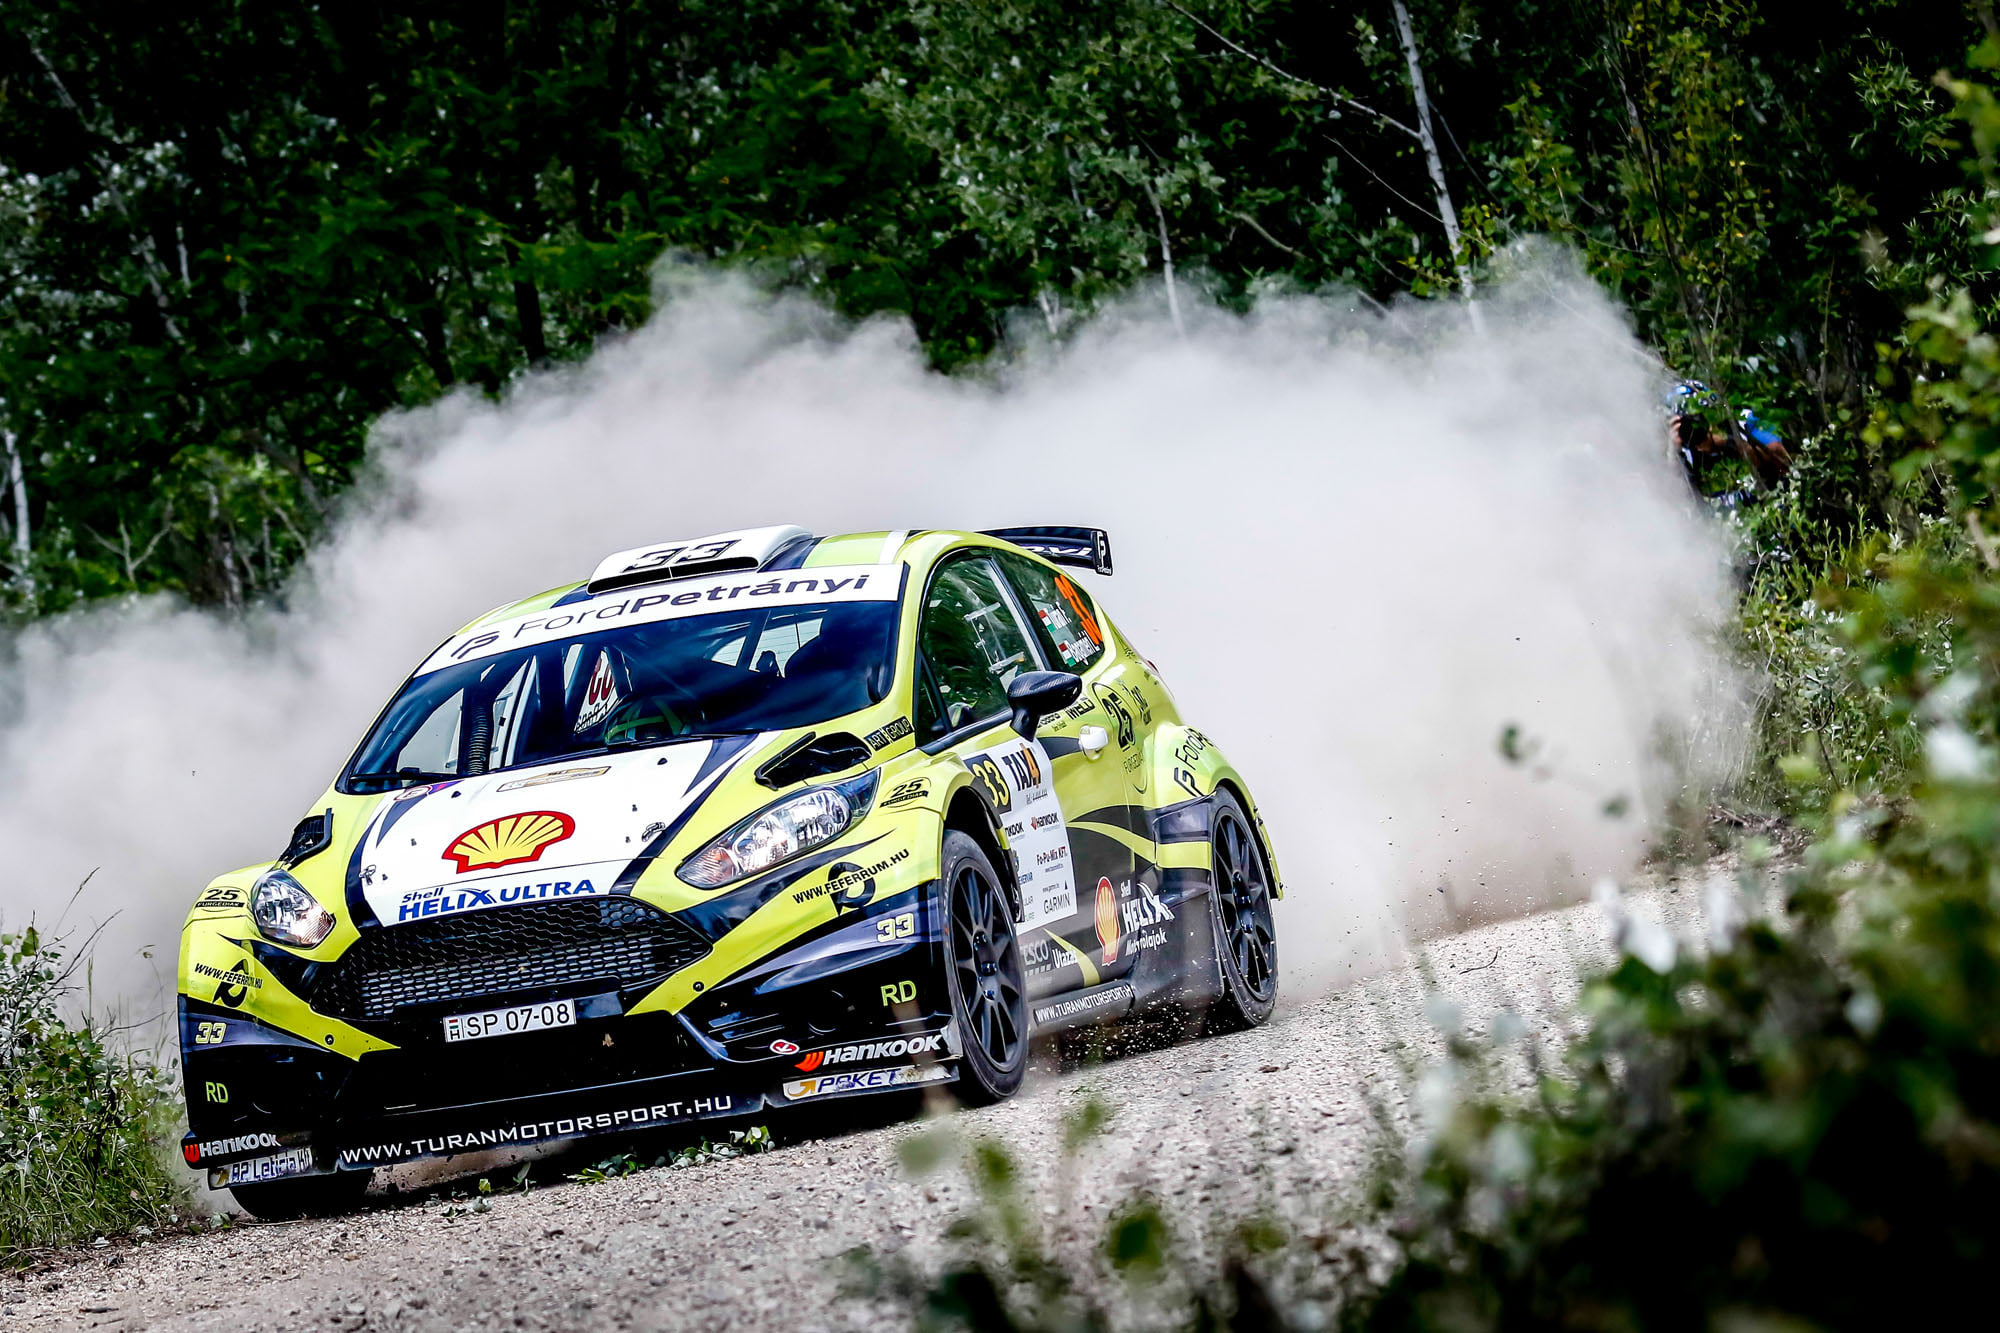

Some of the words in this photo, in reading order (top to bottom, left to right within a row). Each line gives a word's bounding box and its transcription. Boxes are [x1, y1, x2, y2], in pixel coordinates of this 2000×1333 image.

[620, 540, 741, 573] 33
[514, 575, 870, 638] FordPetrányi
[1054, 573, 1104, 645] 33
[868, 732, 887, 749] ART
[886, 718, 910, 739] GROUP
[890, 778, 925, 798] 25
[972, 760, 1009, 808] 33
[792, 849, 910, 904] WWW.FEFERRUM.HU
[1121, 880, 1131, 897] Shell
[205, 889, 240, 901] 25
[399, 888, 497, 921] HELIX
[500, 880, 595, 902] ULTRA
[402, 887, 444, 903] Shell
[1043, 893, 1070, 914] GARMIN
[1121, 882, 1175, 934] HELIX
[877, 913, 915, 943] 33
[880, 980, 917, 1006] RD
[196, 1022, 227, 1044] 33
[467, 1013, 498, 1037] SP
[506, 1003, 570, 1032] 07-08
[206, 1081, 229, 1103] RD
[342, 1095, 732, 1163] WWW.TURANMOTORSPORT.HU
